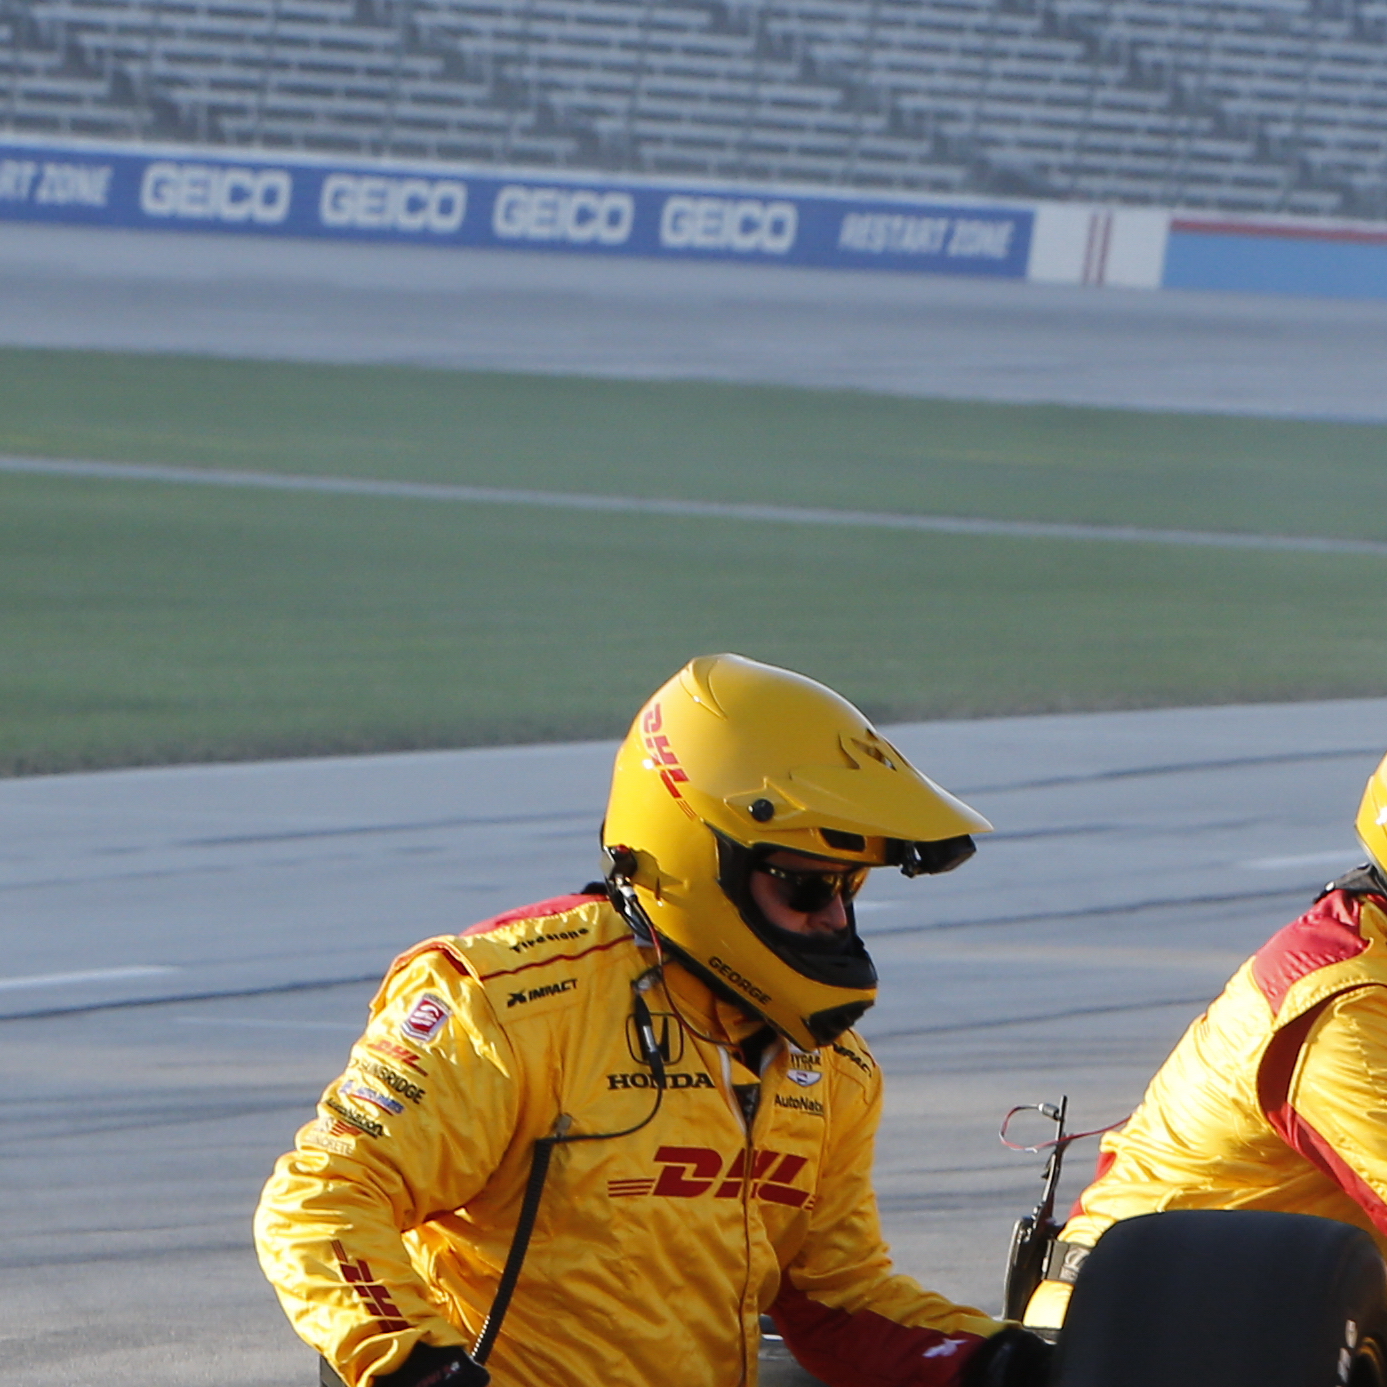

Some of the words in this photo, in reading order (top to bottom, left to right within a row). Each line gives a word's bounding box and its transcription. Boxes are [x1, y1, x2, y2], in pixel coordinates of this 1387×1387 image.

[36, 165, 112, 207] ZONE
[142, 163, 292, 222] GEICO
[320, 173, 467, 233] GEICO
[493, 187, 634, 243] GEICO
[660, 198, 798, 254] GEICO
[838, 211, 947, 253] RESTART
[946, 219, 1015, 257] ZONE
[639, 703, 691, 800] DHL
[509, 927, 590, 955] Firestone
[528, 977, 579, 1003] IMPACT
[707, 955, 773, 1006] GEORGE
[607, 1072, 716, 1091] HONDA
[652, 1145, 810, 1208] DHL
